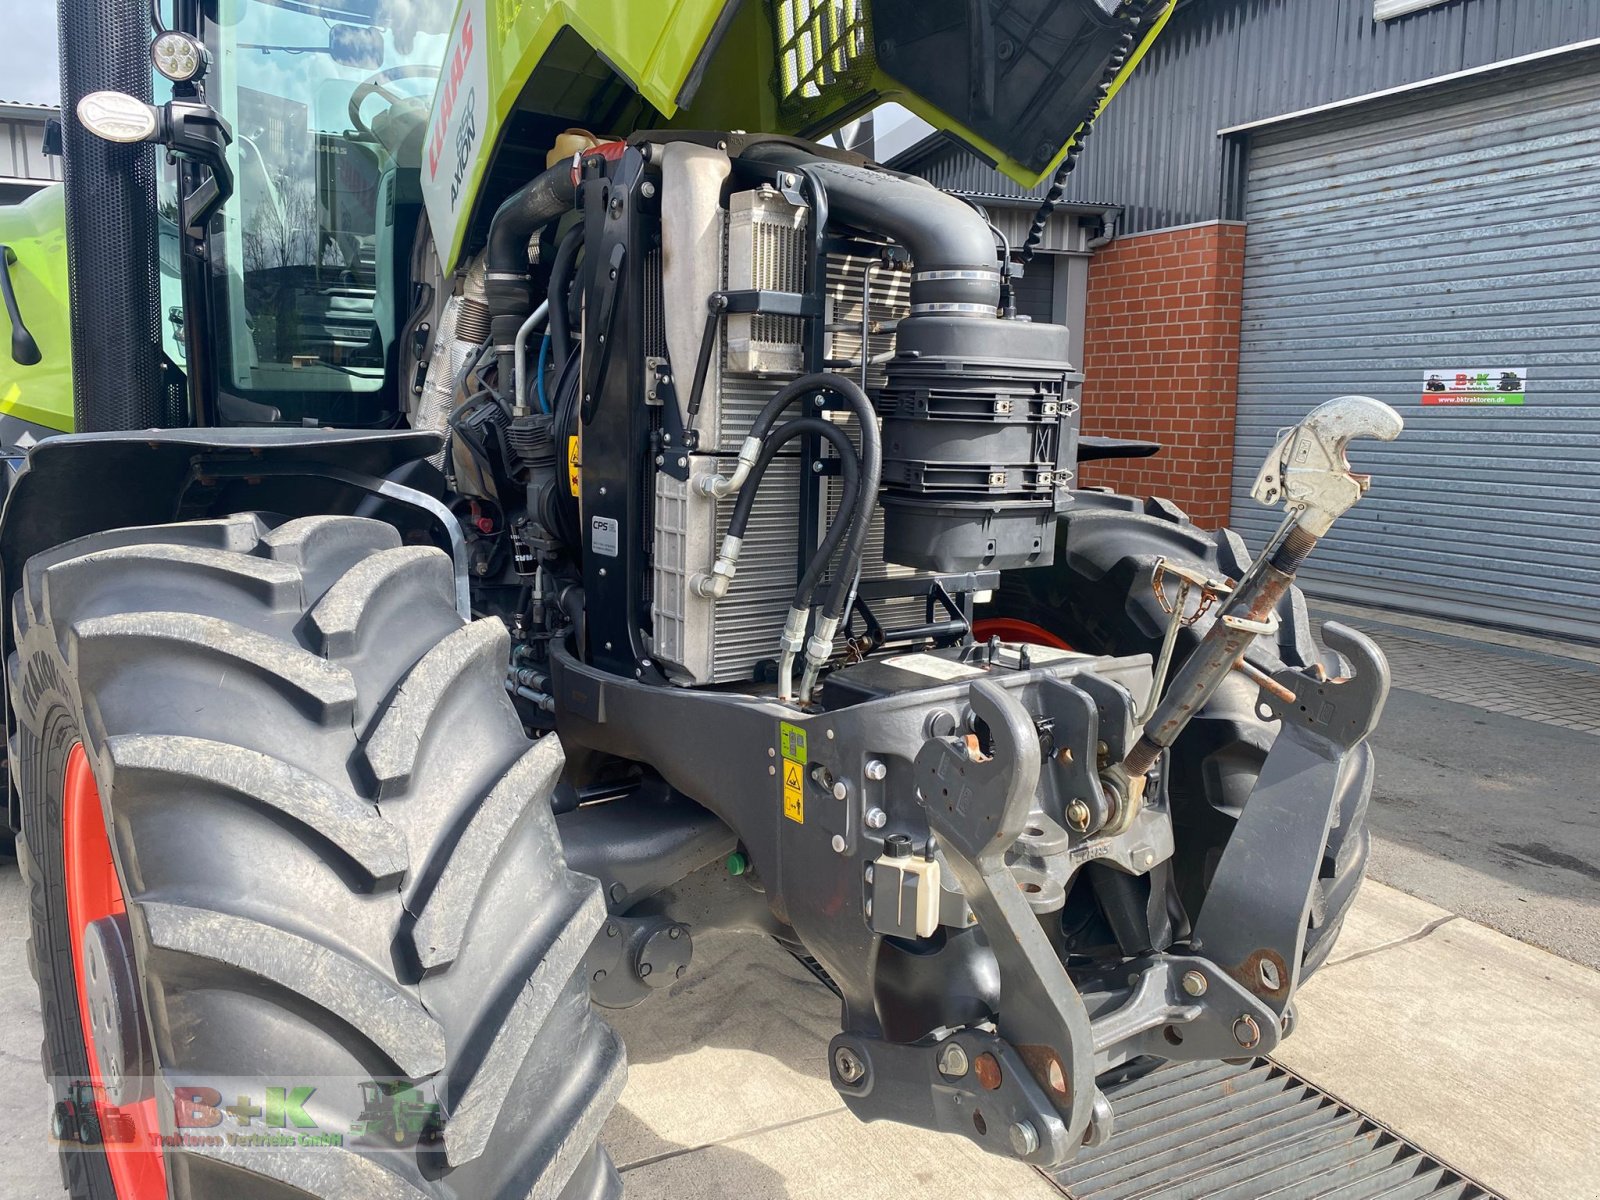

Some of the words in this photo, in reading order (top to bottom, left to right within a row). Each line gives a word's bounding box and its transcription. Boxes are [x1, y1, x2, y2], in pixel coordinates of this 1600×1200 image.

[429, 9, 473, 183] CLAAS
[456, 86, 475, 158] 850
[451, 115, 476, 213] AXION
[1455, 373, 1489, 386] B+K
[593, 521, 608, 531] CPS
